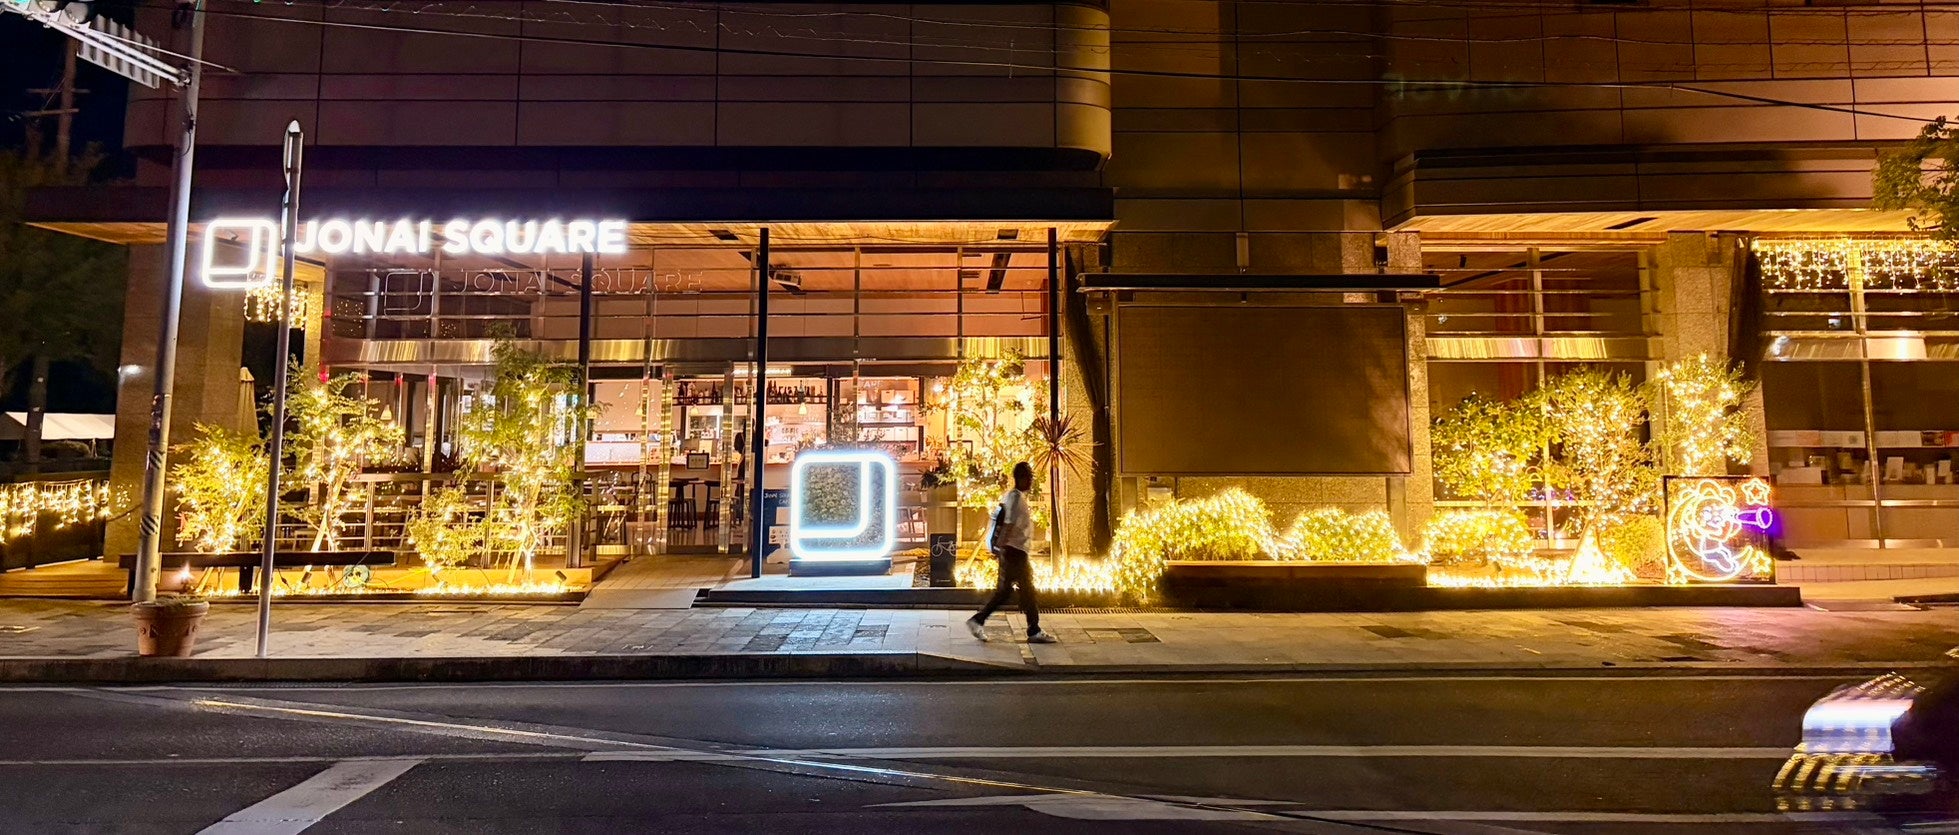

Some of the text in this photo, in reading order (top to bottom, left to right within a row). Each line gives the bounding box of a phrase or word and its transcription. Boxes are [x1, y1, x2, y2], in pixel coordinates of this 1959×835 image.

[293, 218, 626, 254] JONAI SQUARE
[452, 268, 555, 294] JONAI
